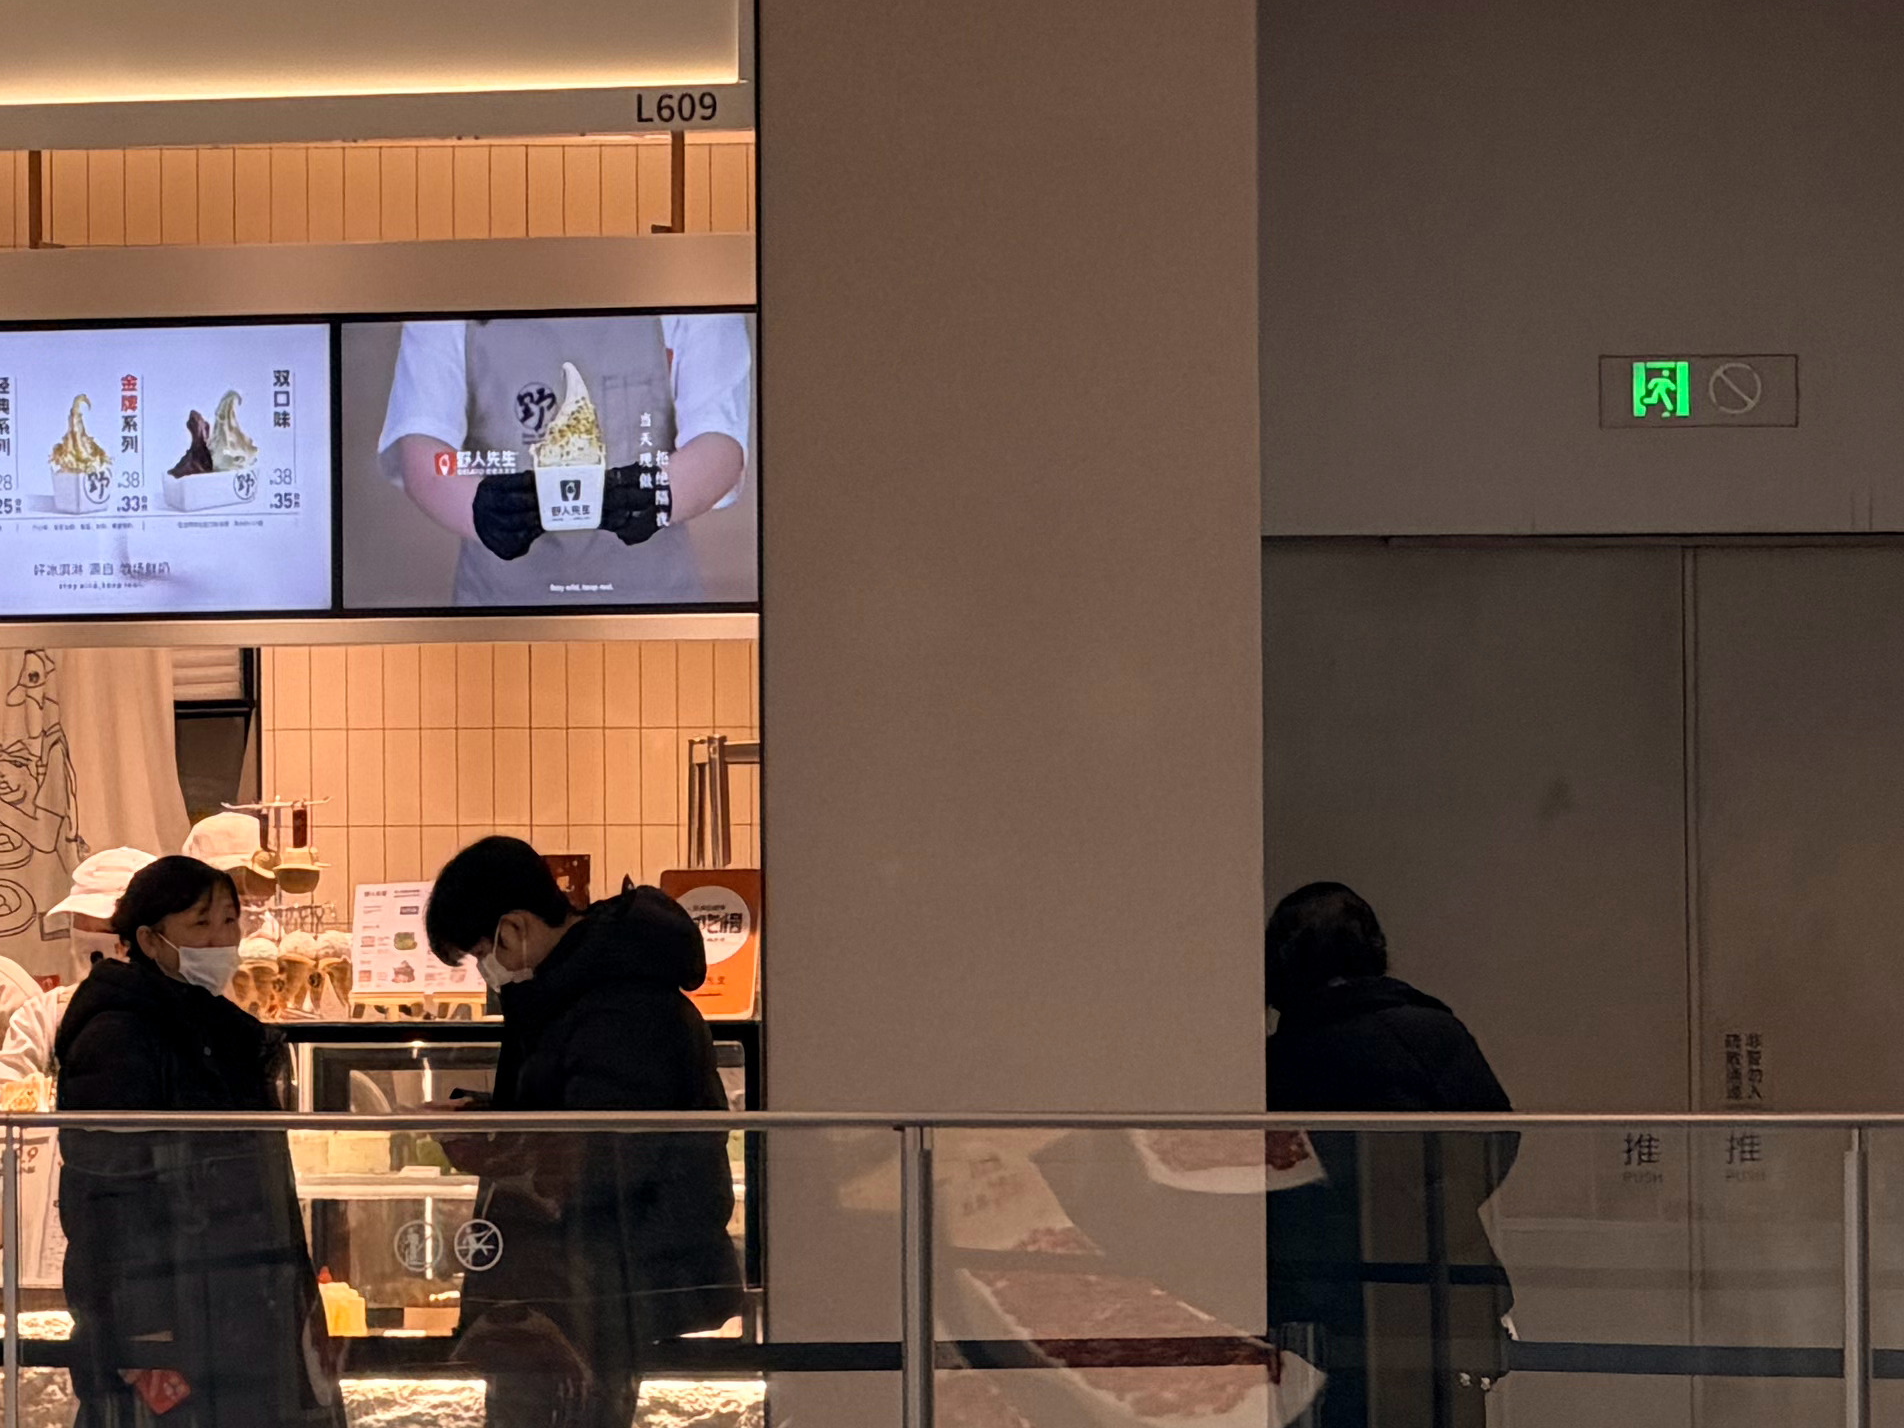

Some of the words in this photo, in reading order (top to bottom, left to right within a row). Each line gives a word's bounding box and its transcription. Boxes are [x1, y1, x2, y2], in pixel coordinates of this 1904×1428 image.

[636, 93, 718, 124] L609
[121, 374, 138, 453] 金牌系列
[273, 370, 290, 428] 双口味
[456, 450, 517, 468] 野人先生
[1624, 1132, 1660, 1166] 推
[1726, 1131, 1762, 1165] 推
[1623, 1172, 1663, 1184] PUSH
